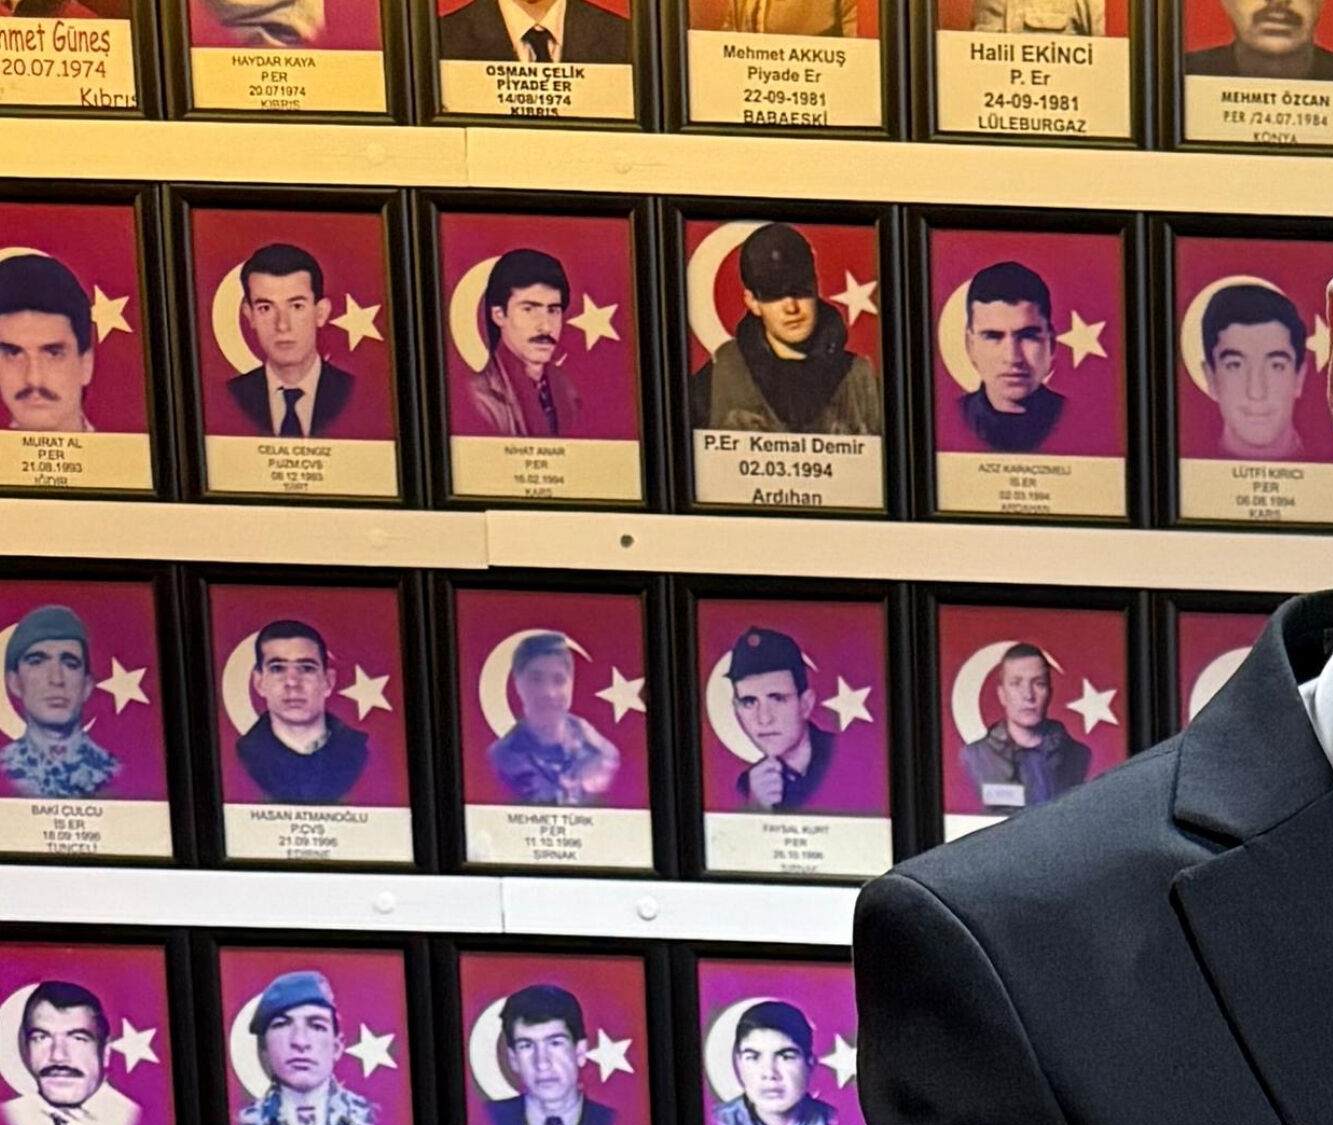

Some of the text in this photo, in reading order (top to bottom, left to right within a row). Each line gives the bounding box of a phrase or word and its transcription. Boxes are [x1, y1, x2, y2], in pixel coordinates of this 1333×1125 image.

[52, 20, 110, 57] Güneş
[232, 56, 316, 67] HAYDAR KAYA
[723, 44, 846, 66] Mehmet AKKUŞ
[971, 41, 1093, 65] Halil EKİNCİ
[2, 58, 106, 78] 20.07.1974
[485, 65, 585, 83] OSMAN ÇELİK
[748, 66, 822, 84] Piyade Er
[1010, 69, 1051, 85] P. Er
[497, 78, 572, 93] PİYADE ER
[744, 88, 826, 106] 22-09-1981
[984, 92, 1078, 111] 24-09-1981
[1221, 91, 1330, 107] MEHMET ÖZCAN
[978, 113, 1086, 133] LÜLEBURGAZ
[22, 437, 83, 449] MURAT AL
[704, 435, 865, 455] P.Er Kemal Demir
[739, 460, 833, 478] 02.03.1994
[752, 488, 822, 506] Ardıhan
